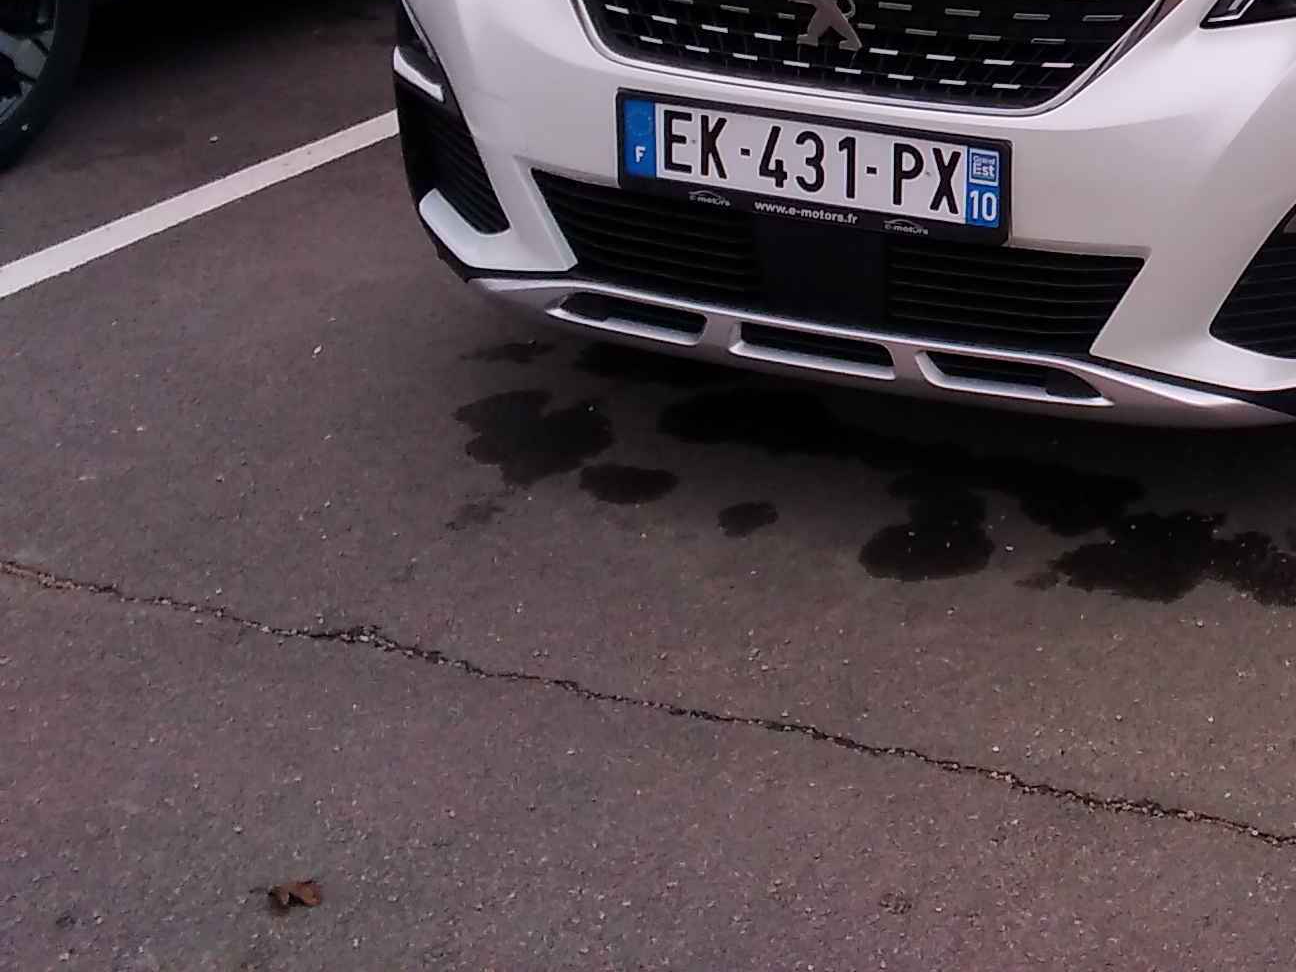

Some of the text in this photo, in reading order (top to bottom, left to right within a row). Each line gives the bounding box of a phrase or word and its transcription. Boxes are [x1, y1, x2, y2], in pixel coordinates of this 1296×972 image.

[634, 145, 646, 163] F
[663, 108, 963, 215] EK-431-PX
[972, 161, 995, 177] Est
[754, 201, 858, 225] www.e-motors.fr
[969, 189, 997, 222] 10
